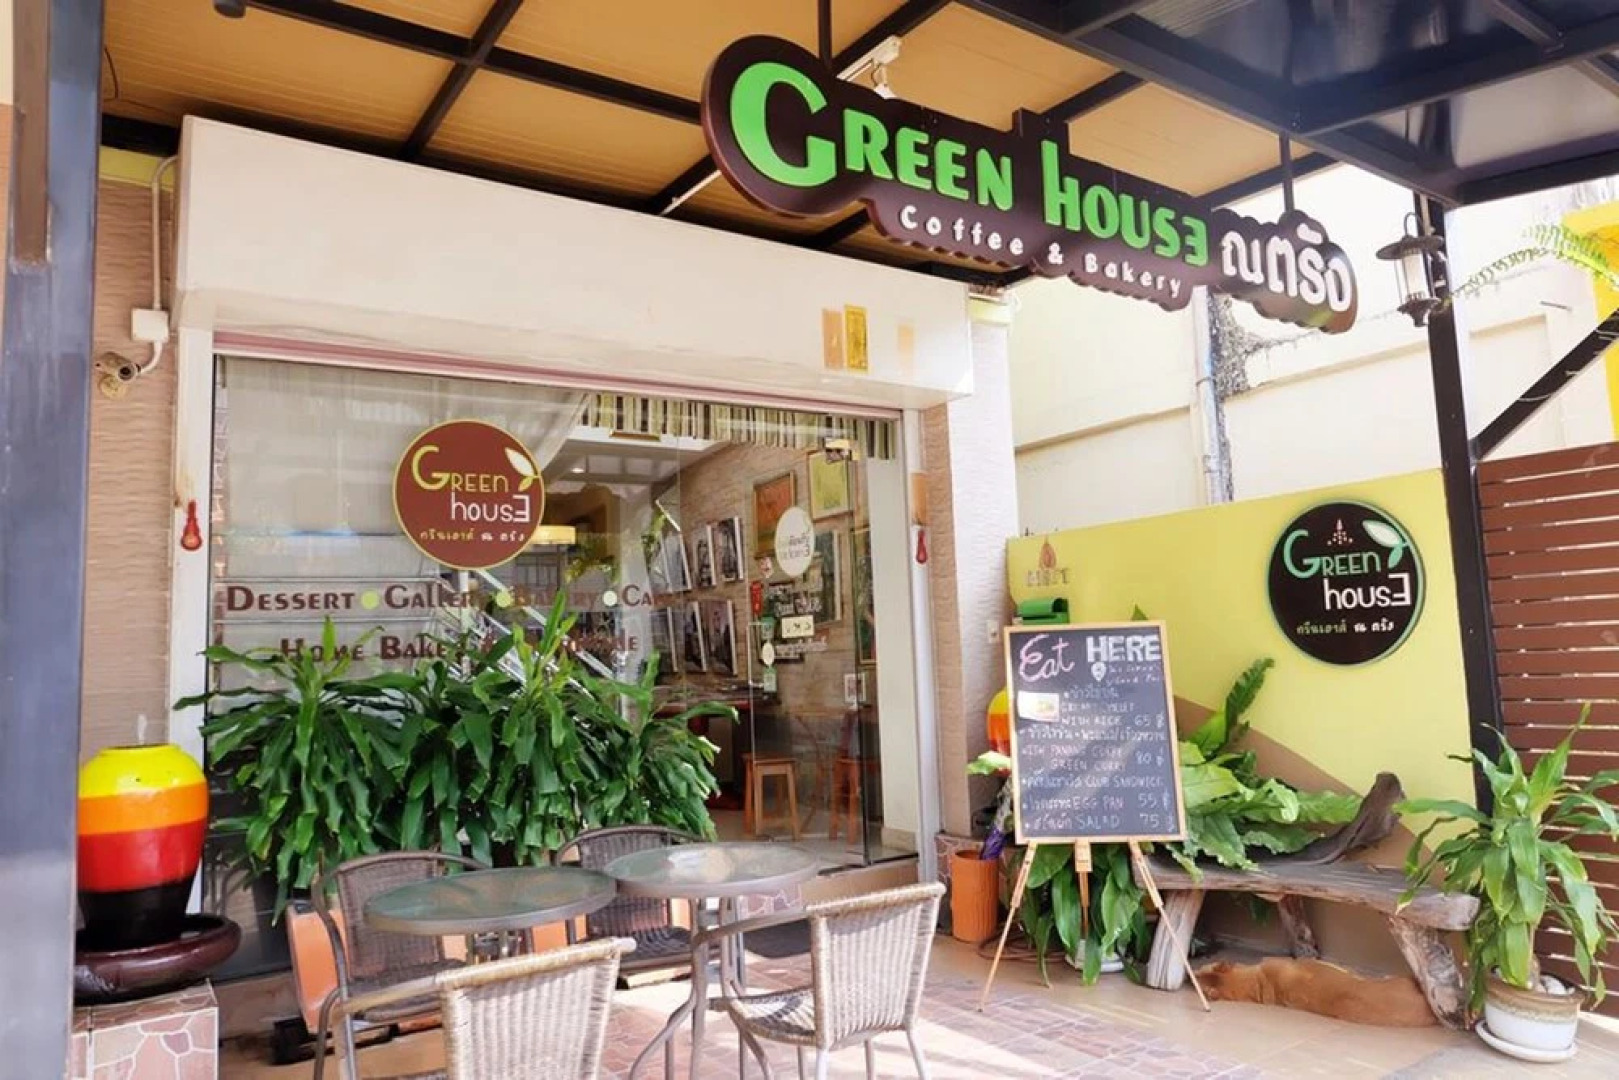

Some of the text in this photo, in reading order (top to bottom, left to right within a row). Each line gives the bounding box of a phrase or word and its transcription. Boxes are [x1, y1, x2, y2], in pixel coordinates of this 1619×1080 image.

[730, 61, 1014, 211] GREEN
[900, 204, 1181, 298] Coffee & Bakery
[227, 585, 355, 611] DESSERT
[1019, 634, 1162, 682] Eat HERE
[1139, 813, 1159, 828] 75
